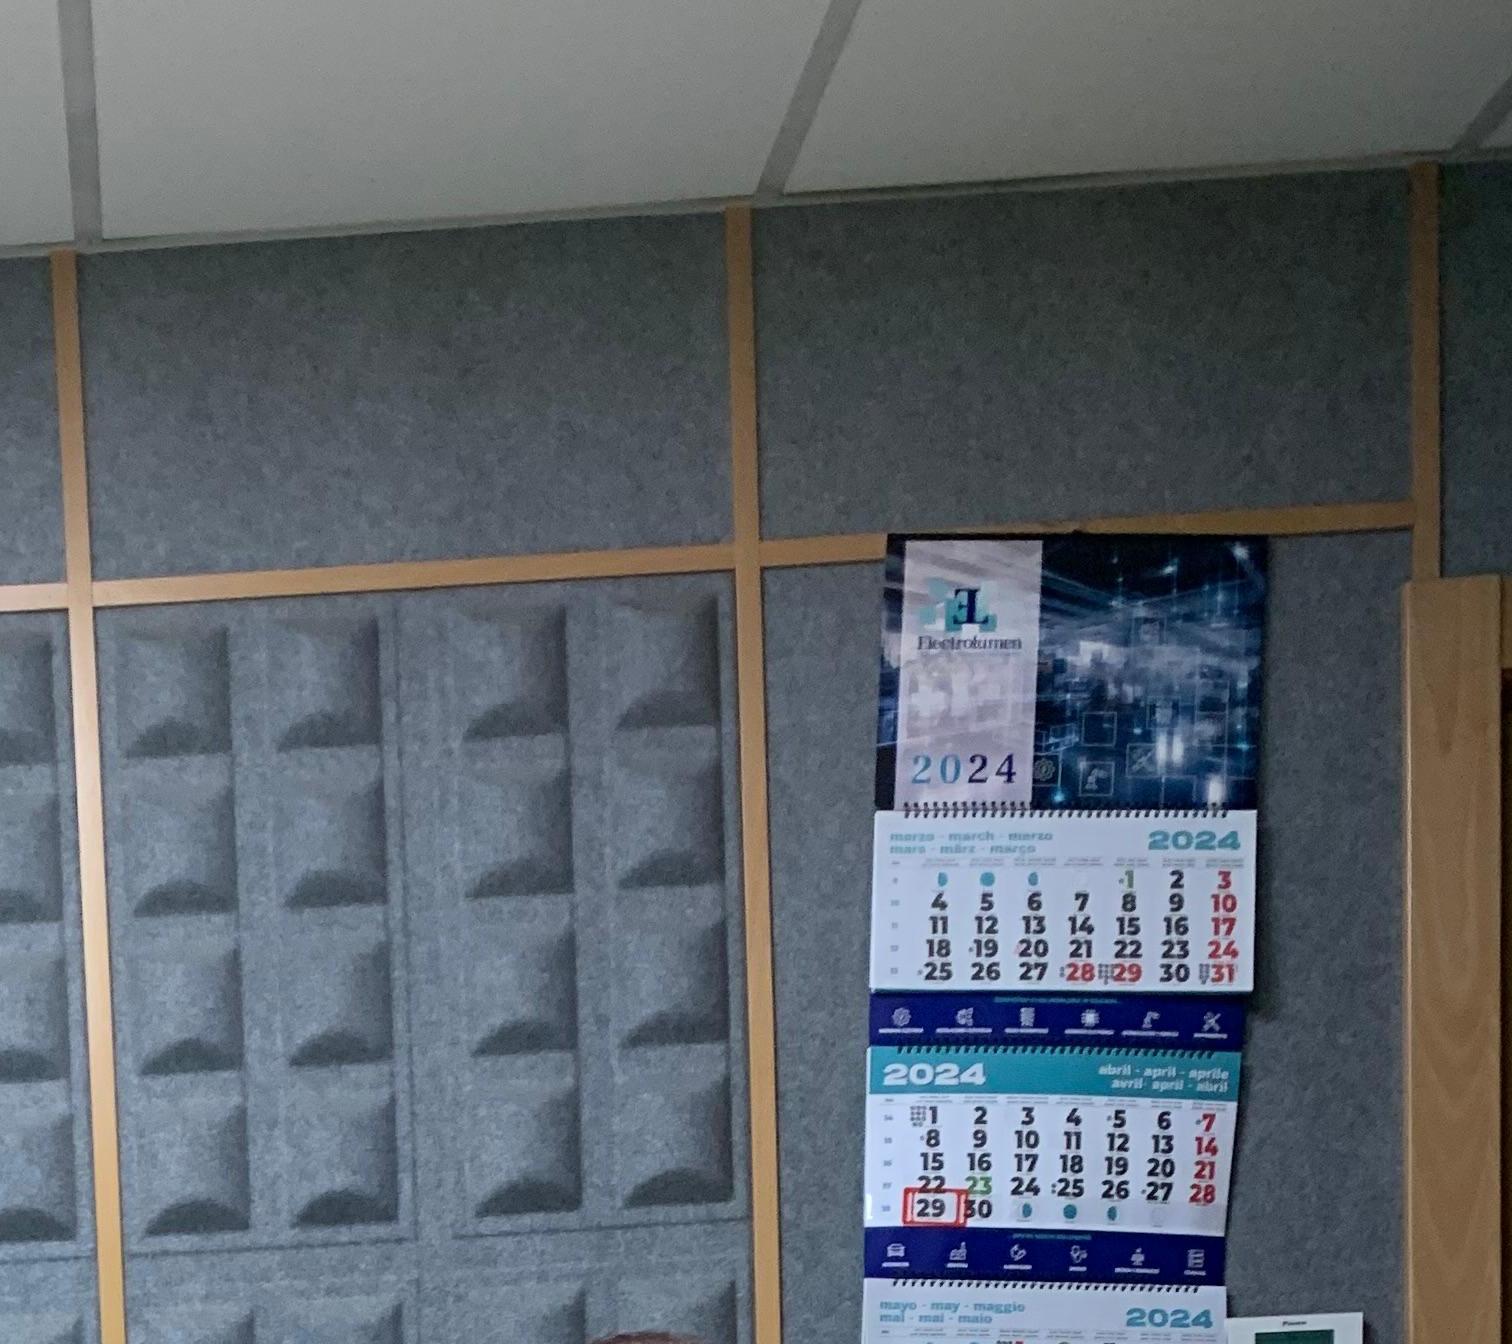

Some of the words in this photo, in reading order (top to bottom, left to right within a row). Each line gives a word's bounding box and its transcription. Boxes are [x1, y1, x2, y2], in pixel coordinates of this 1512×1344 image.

[917, 636, 1022, 650] Electrolumen
[911, 753, 1017, 784] 2024
[1148, 830, 1241, 850] 2024
[1125, 870, 1134, 889] 1
[1170, 870, 1184, 889] 2
[1217, 870, 1231, 889] 3
[931, 891, 948, 911] 4
[980, 892, 994, 912] 5
[1027, 891, 1042, 912] 6
[1074, 893, 1090, 912] 7
[1121, 893, 1136, 912] 8
[1169, 893, 1184, 912] 9
[1211, 894, 1237, 912] 10
[929, 915, 949, 934] 11
[975, 915, 999, 934] 12
[1021, 915, 1046, 934] 13
[1068, 916, 1094, 935] 14
[1116, 916, 1140, 936] 15
[1163, 916, 1189, 936] 16
[1211, 917, 1236, 936] 17
[926, 939, 951, 957] 18
[973, 939, 999, 957] 19
[1018, 939, 1049, 957] 20
[1069, 939, 1093, 958] 21
[1114, 940, 1143, 959] 22
[1161, 940, 1190, 959] 23
[1208, 940, 1239, 959] 24
[923, 962, 953, 981] 25
[971, 962, 1001, 981] 26
[1019, 962, 1048, 981] 27
[1066, 963, 1095, 982] 28
[1112, 963, 1142, 983] 29
[1159, 963, 1190, 983] 30
[1211, 964, 1235, 983] 31
[883, 1062, 986, 1086] 2024
[1143, 1066, 1176, 1078] april
[929, 1106, 938, 1124] 1
[974, 1106, 988, 1125] 2
[1021, 1107, 1034, 1125] 3
[1066, 1108, 1082, 1126] 4
[1112, 1110, 1126, 1128] 5
[1157, 1111, 1171, 1130] 6
[1202, 1113, 1216, 1132] 7
[926, 1129, 940, 1148] 8
[973, 1130, 987, 1148] 9
[1014, 1130, 1040, 1149] 10
[1063, 1131, 1082, 1150] 11
[1107, 1133, 1129, 1152] 12
[1152, 1135, 1174, 1154] 13
[1195, 1136, 1219, 1156] 14
[920, 1152, 944, 1171] 15
[967, 1153, 992, 1171] 16
[1014, 1153, 1038, 1172] 17
[1059, 1155, 1083, 1173] 18
[1104, 1156, 1128, 1176] 19
[1147, 1158, 1175, 1177] 20
[1194, 1161, 1215, 1180] 21
[918, 1175, 946, 1194] 22
[965, 1176, 992, 1195] 23
[1011, 1177, 1040, 1196] 24
[1057, 1178, 1084, 1197] 25
[1101, 1180, 1130, 1199] 26
[1146, 1182, 1173, 1201] 27
[1189, 1184, 1216, 1203] 28
[917, 1199, 945, 1217] 29
[963, 1199, 992, 1218] 30
[879, 1301, 917, 1313] mayo
[930, 1302, 961, 1313] may
[973, 1301, 1026, 1314] maggio
[1126, 1307, 1213, 1328] 2024
